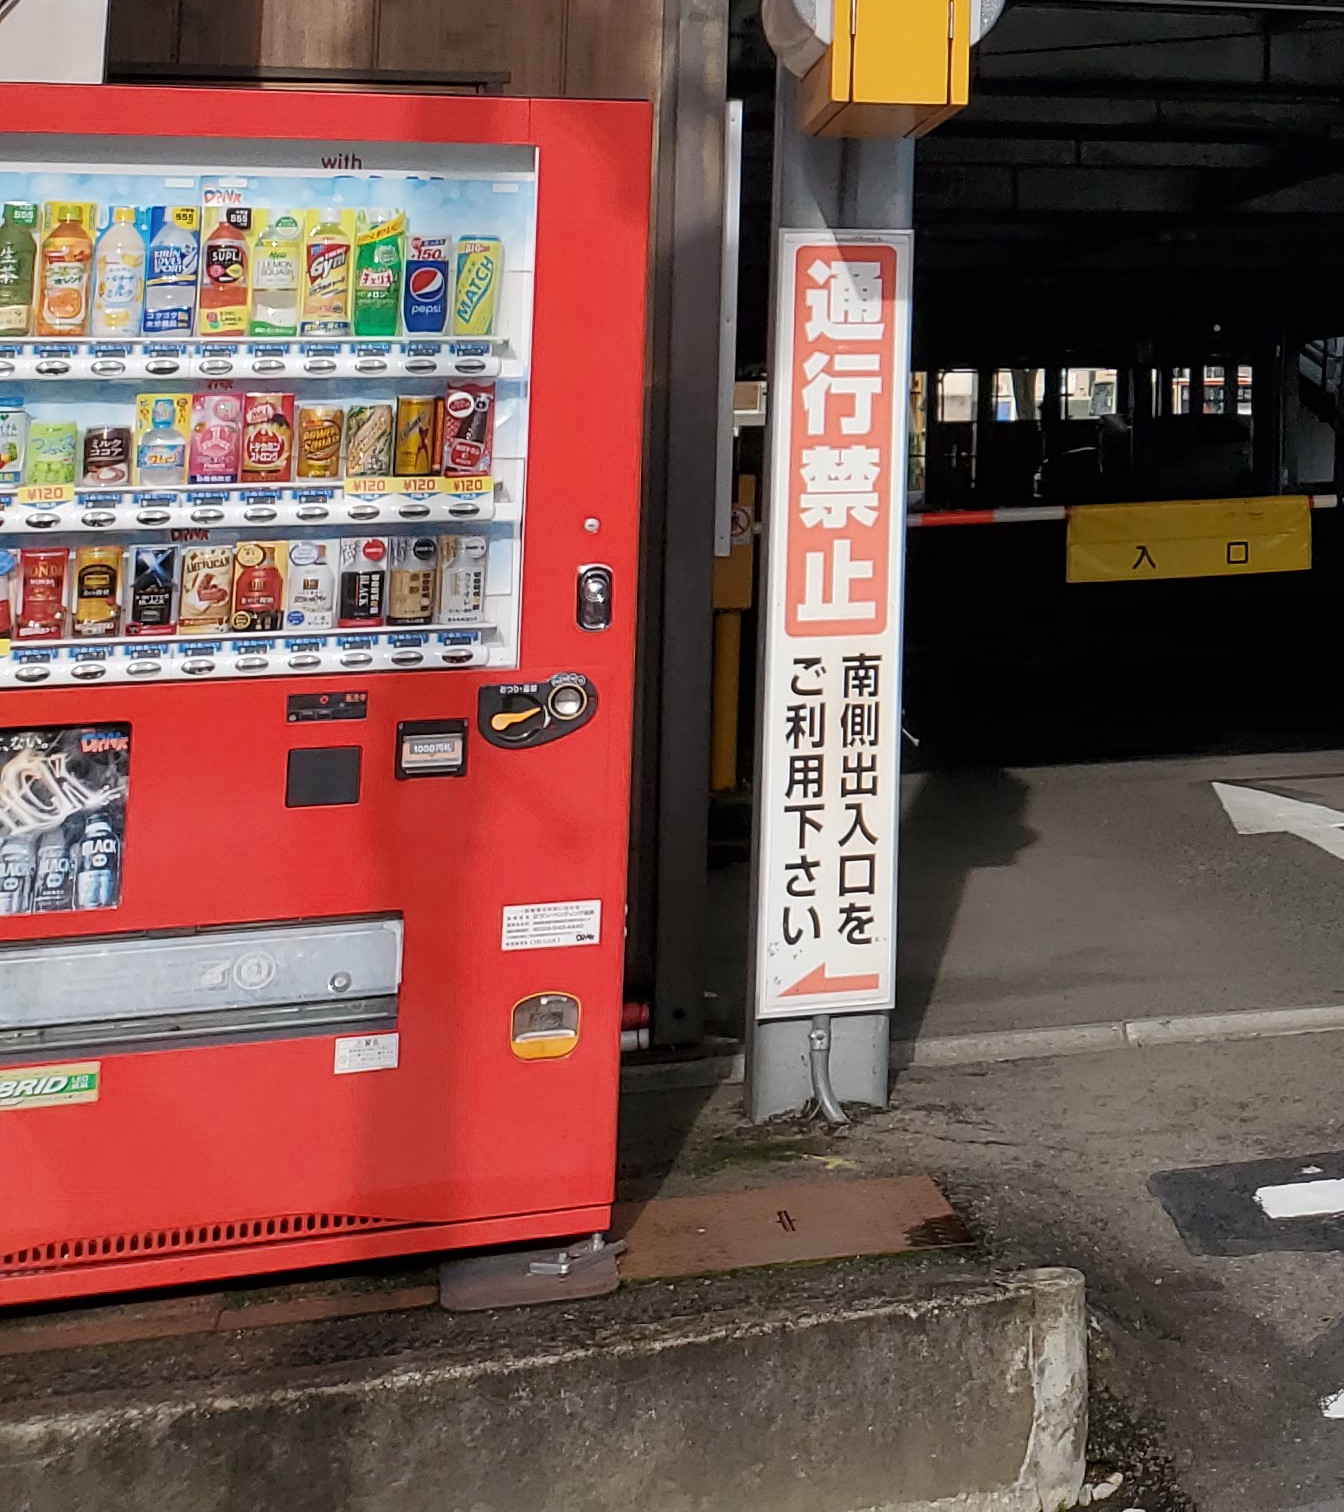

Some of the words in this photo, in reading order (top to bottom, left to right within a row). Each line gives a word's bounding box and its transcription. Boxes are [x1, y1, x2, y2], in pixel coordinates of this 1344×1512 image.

[321, 153, 363, 170] with
[411, 304, 442, 316] pepsi
[456, 254, 495, 324] MATCH
[797, 259, 885, 622] 通行禁止
[1132, 542, 1250, 570] 入口
[782, 656, 829, 946] ご利用下さい
[838, 653, 883, 946] 南側出入口を
